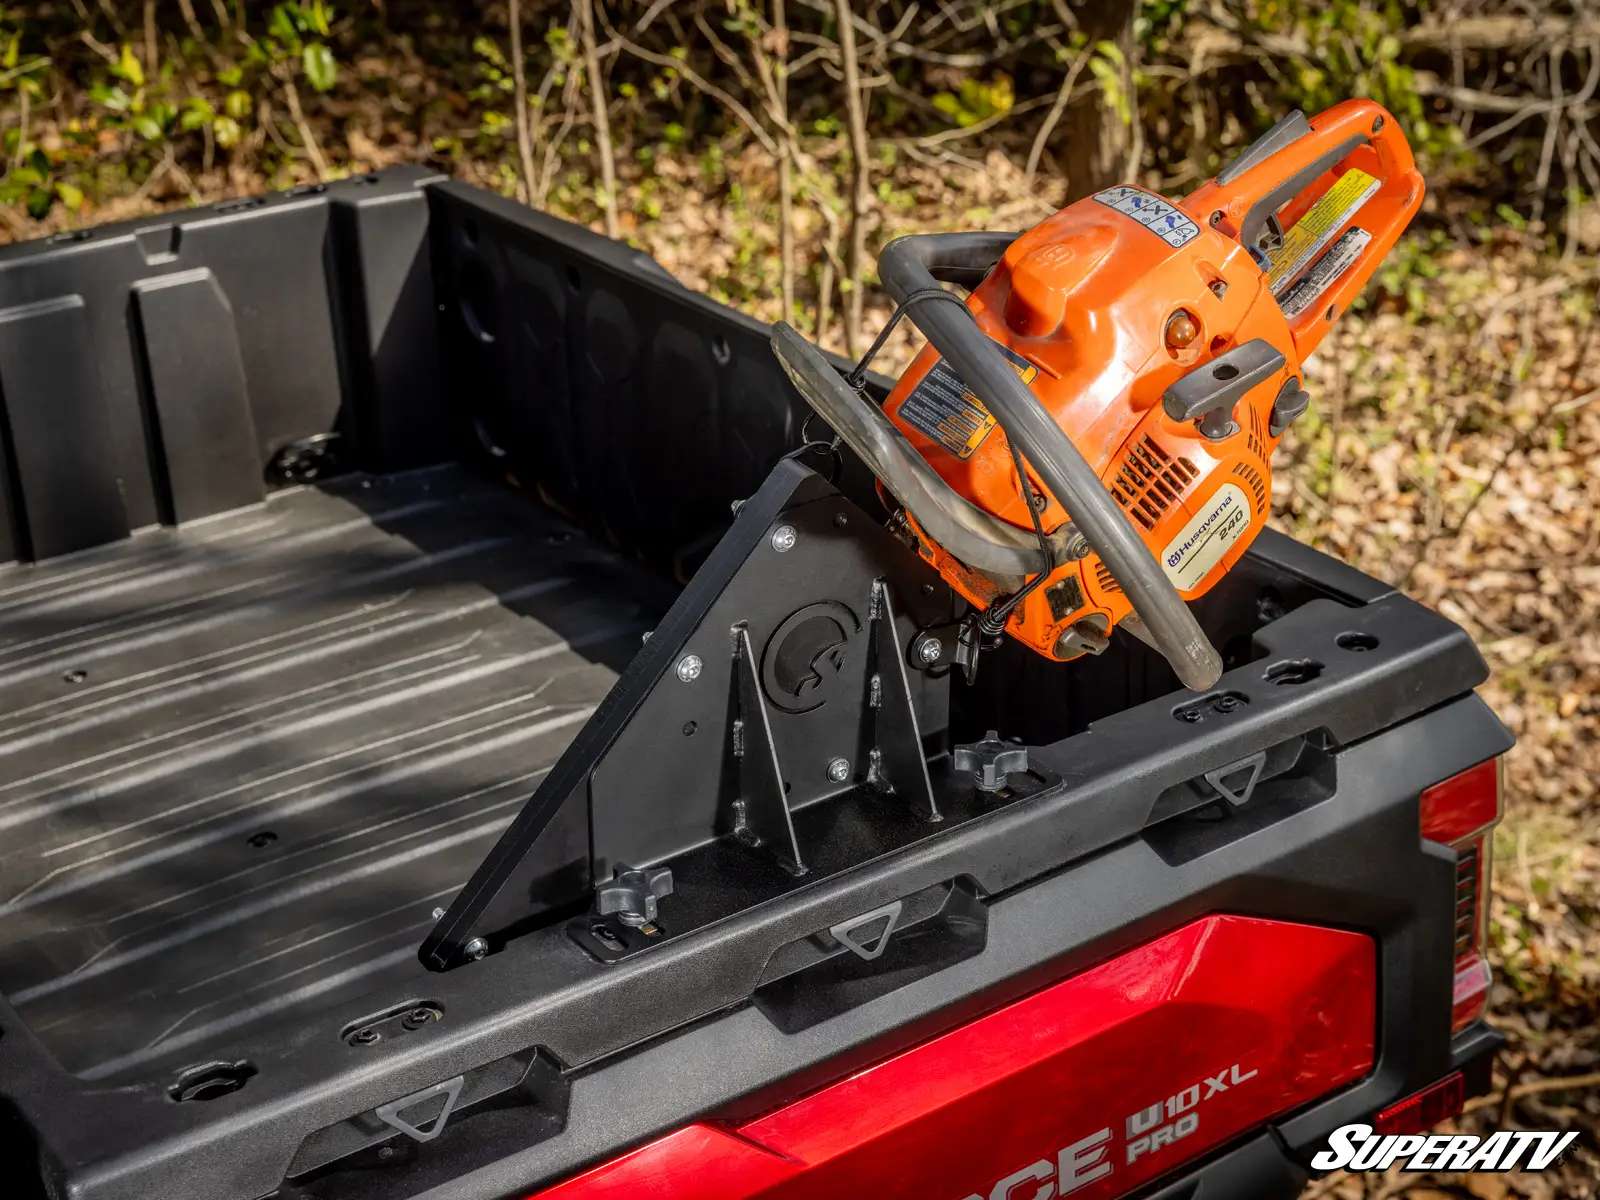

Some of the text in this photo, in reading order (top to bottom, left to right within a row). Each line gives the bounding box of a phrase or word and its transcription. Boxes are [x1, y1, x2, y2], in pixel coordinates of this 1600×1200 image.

[1179, 495, 1233, 556] Husqvarna
[1220, 509, 1244, 541] 240
[1203, 1064, 1258, 1101] XL
[962, 1127, 1113, 1200] CE
[1126, 1112, 1200, 1165] PRO
